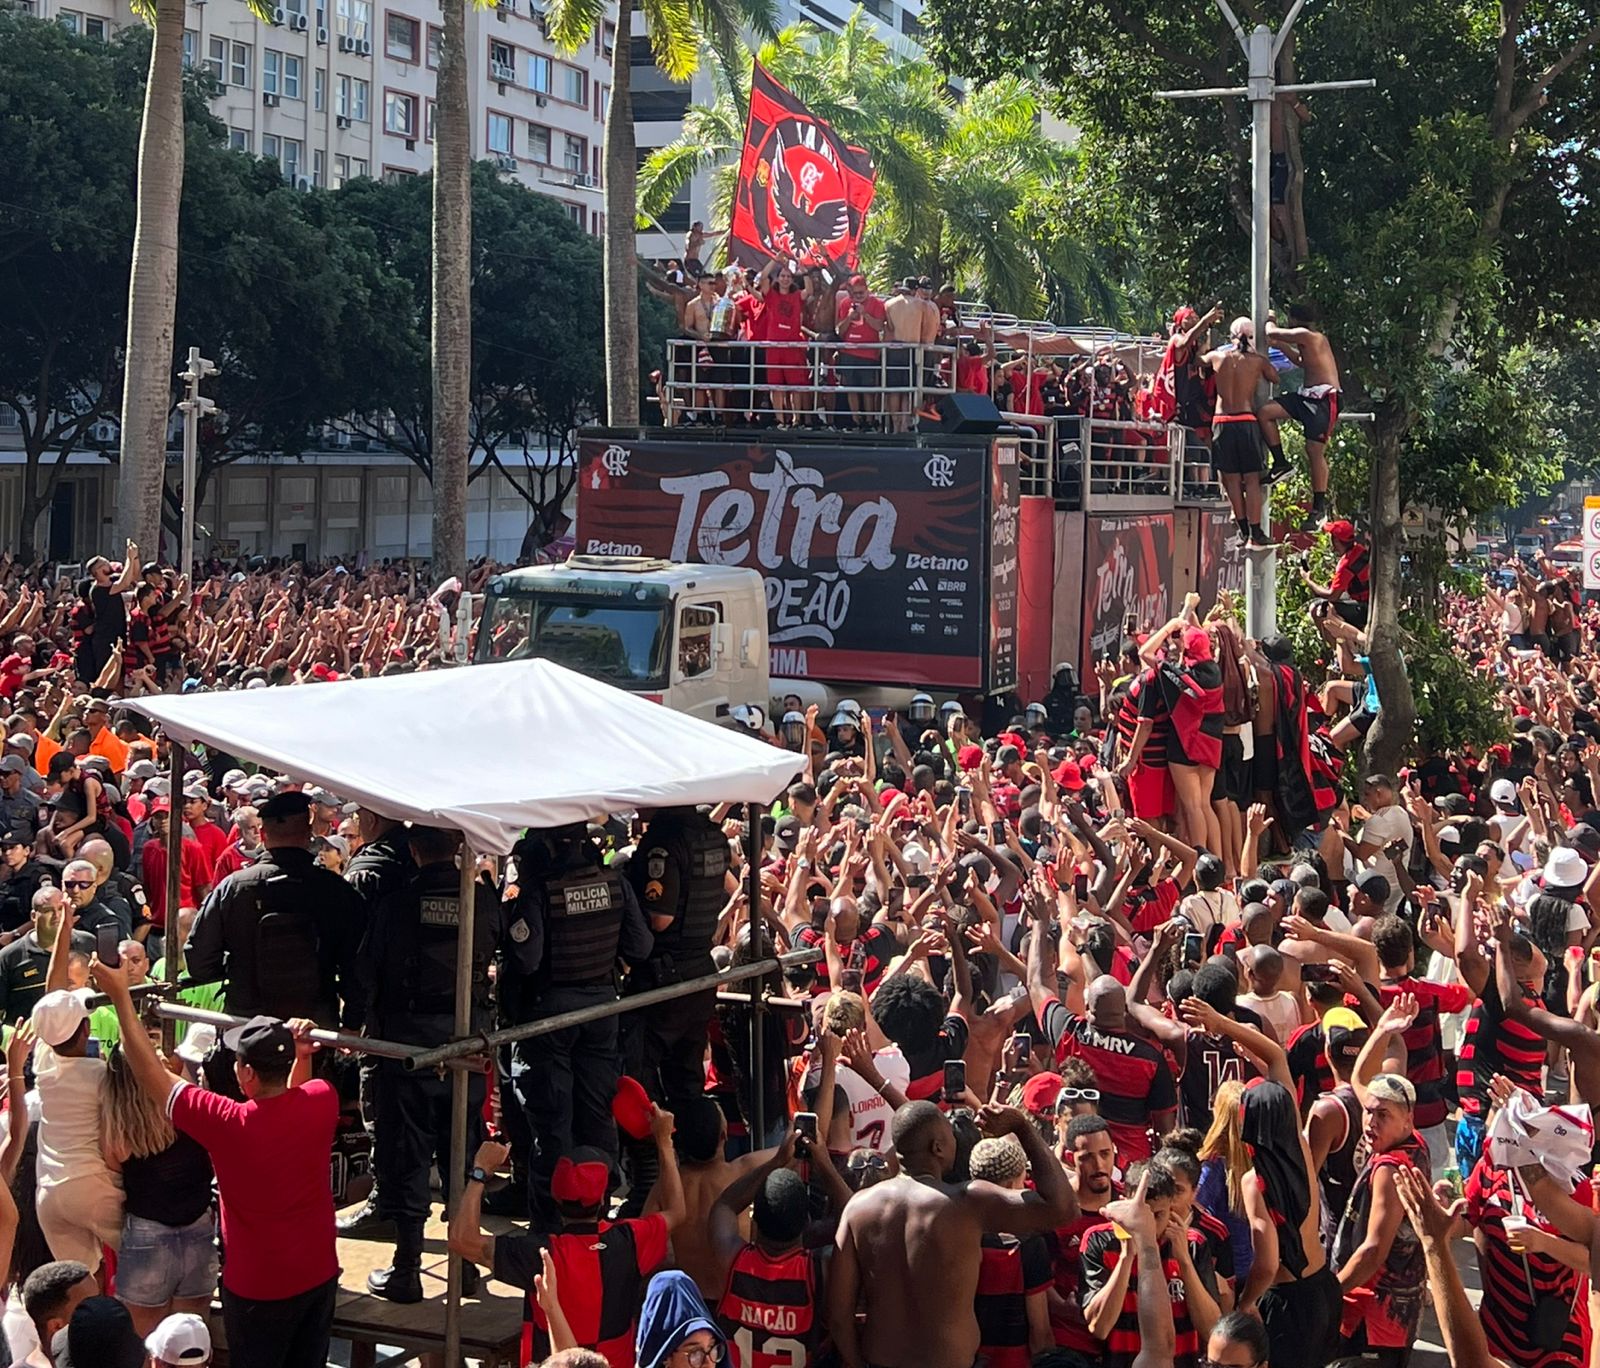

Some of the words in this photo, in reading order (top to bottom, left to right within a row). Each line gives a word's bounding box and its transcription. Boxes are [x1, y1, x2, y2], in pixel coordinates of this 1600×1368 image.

[660, 449, 898, 576] Tetra
[586, 539, 643, 556] Betano
[906, 553, 969, 571] Betano
[763, 571, 851, 630] PEÃO
[769, 648, 808, 676] HMA
[567, 886, 608, 902] POLÍCIA
[422, 900, 459, 912] POLÍCI
[567, 898, 609, 913] MILITAR
[422, 912, 460, 924] MILITA
[1092, 1031, 1137, 1055] MRV
